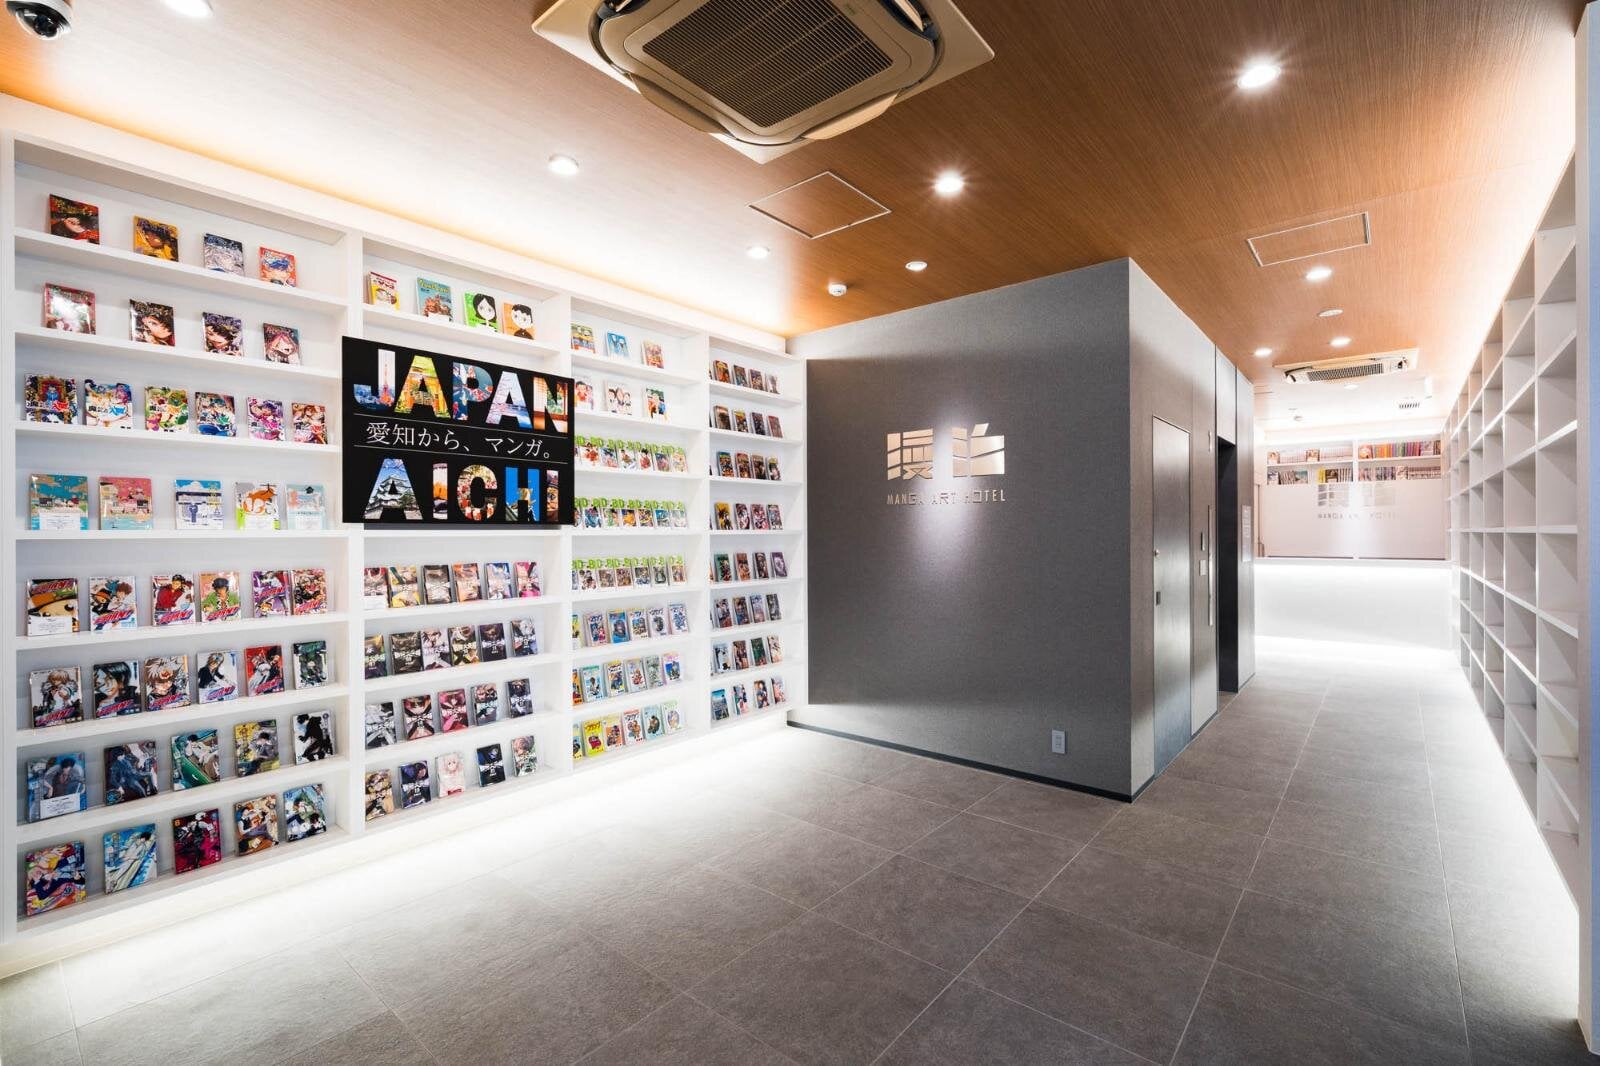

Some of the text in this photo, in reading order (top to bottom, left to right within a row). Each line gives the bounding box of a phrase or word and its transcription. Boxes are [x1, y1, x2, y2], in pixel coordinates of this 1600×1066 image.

[353, 348, 569, 433] JAPAN
[366, 421, 552, 460] 愛知から、マンガ。
[362, 458, 560, 522] AICHI
